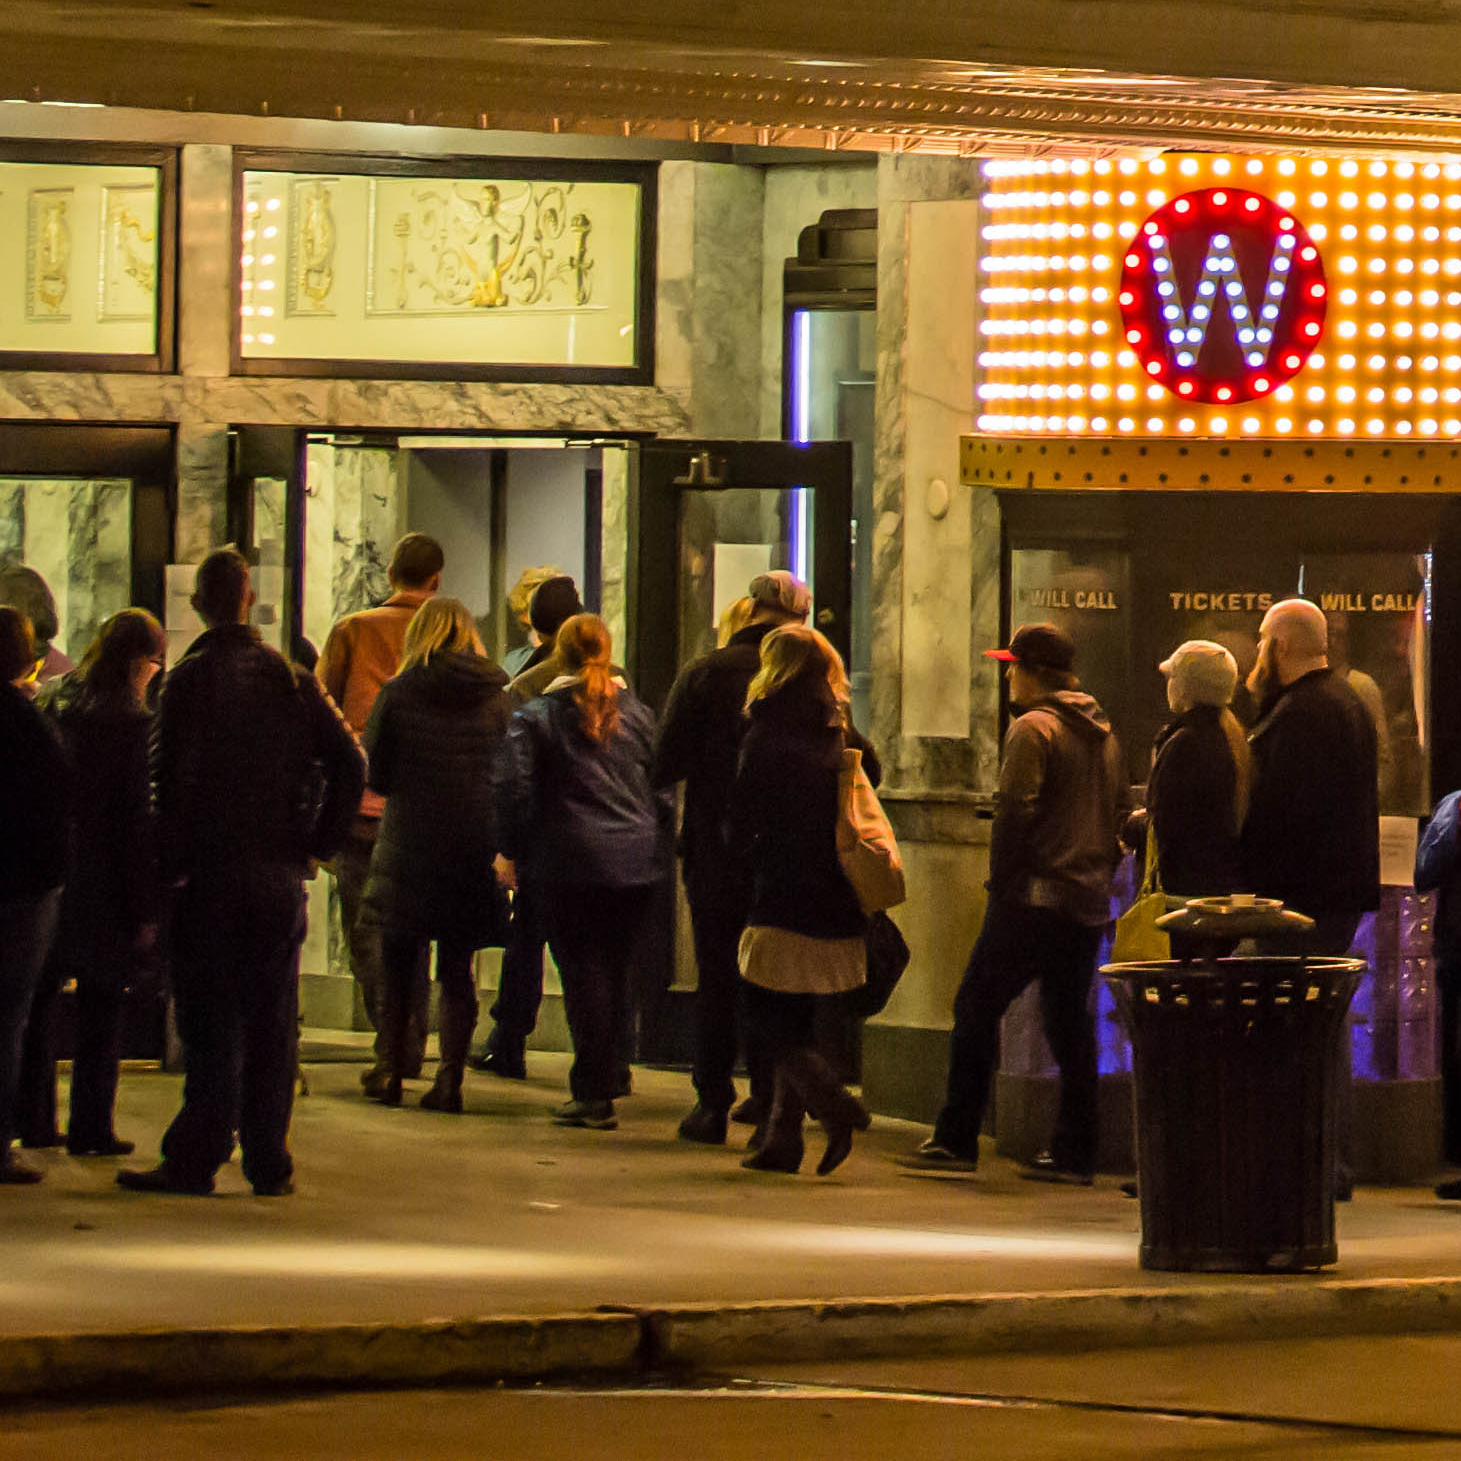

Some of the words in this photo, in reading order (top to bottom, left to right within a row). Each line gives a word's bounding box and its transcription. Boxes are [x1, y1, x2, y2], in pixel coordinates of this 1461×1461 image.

[1148, 234, 1297, 368] W
[1030, 590, 1070, 608] WILL
[1074, 591, 1119, 610] CALL
[1169, 591, 1273, 611] TICKETS
[1320, 592, 1367, 612] WILL
[1371, 592, 1417, 612] CALL
